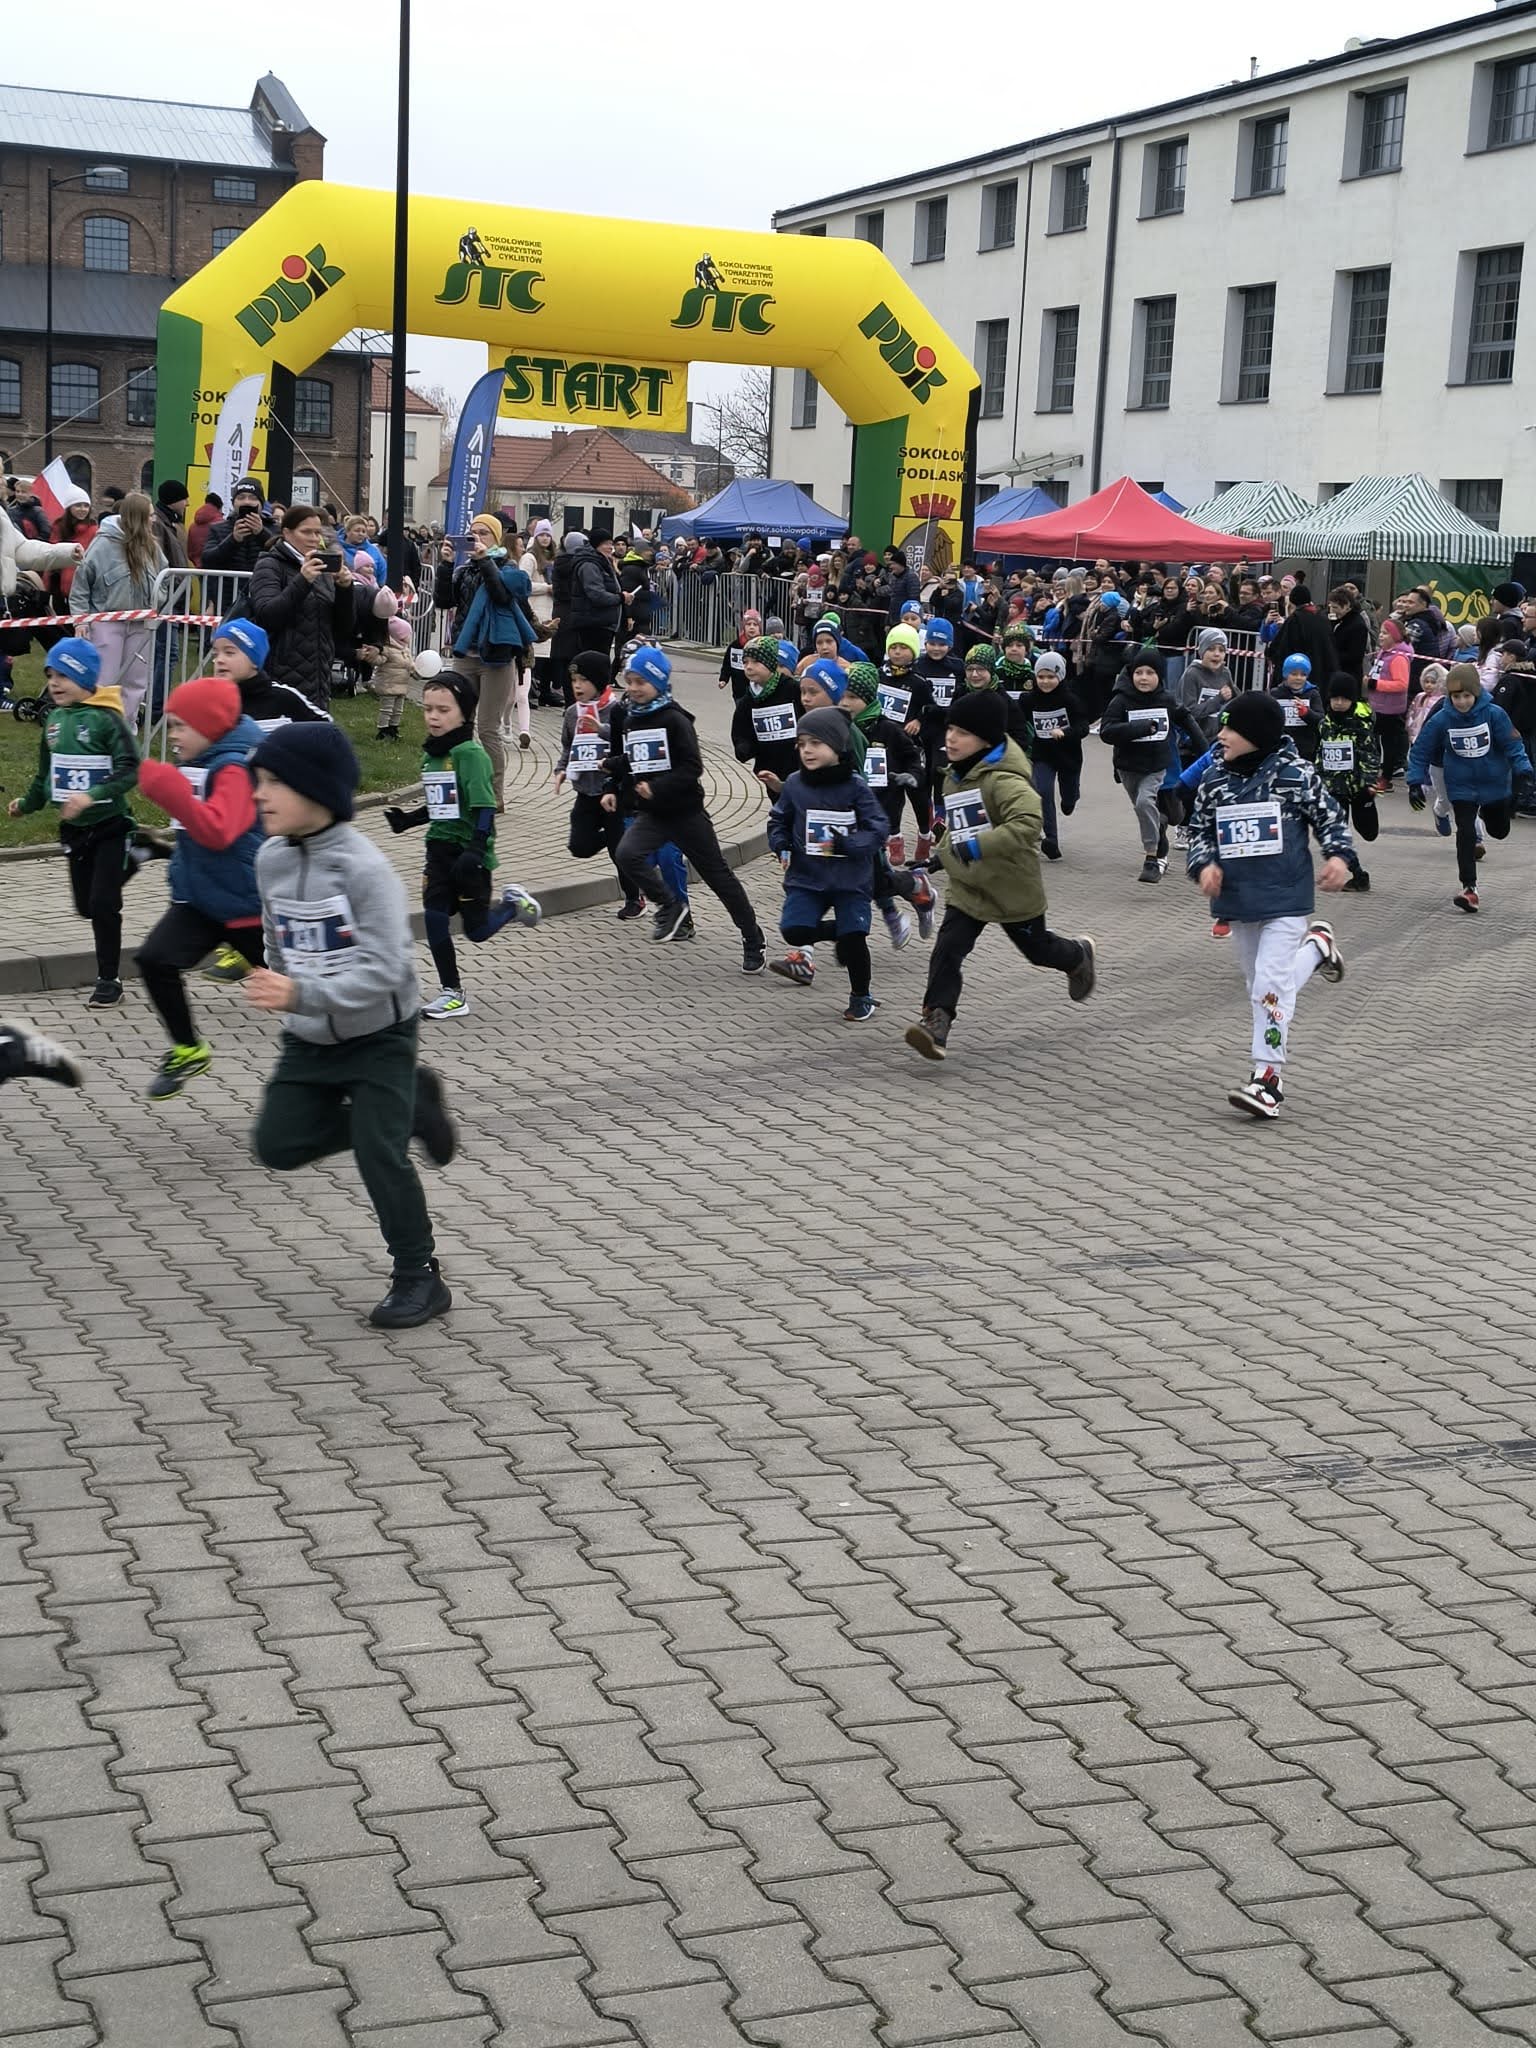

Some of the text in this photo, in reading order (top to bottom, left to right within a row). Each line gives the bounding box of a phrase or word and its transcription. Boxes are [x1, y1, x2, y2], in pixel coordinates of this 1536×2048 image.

[491, 244, 543, 256] TOWARZYSTWO
[498, 253, 542, 264] CYKLISTÓW
[725, 269, 774, 279] TOWARZYSTWO
[434, 262, 546, 314] STC
[732, 279, 773, 287] CYKLISTÓW
[670, 287, 777, 335] STC
[503, 355, 673, 420] START
[898, 446, 969, 463] SOKOŁÓW
[896, 467, 968, 484] PODLASKI
[932, 685, 947, 698] 211
[883, 695, 896, 711] 12
[763, 716, 783, 732] 115
[1040, 718, 1060, 731] 232
[1463, 736, 1479, 750] 98
[577, 744, 598, 761] 125
[633, 742, 650, 761] 88
[1324, 748, 1343, 761] 289
[67, 769, 91, 790] 33
[953, 807, 969, 830] 61
[1228, 819, 1260, 844] 135
